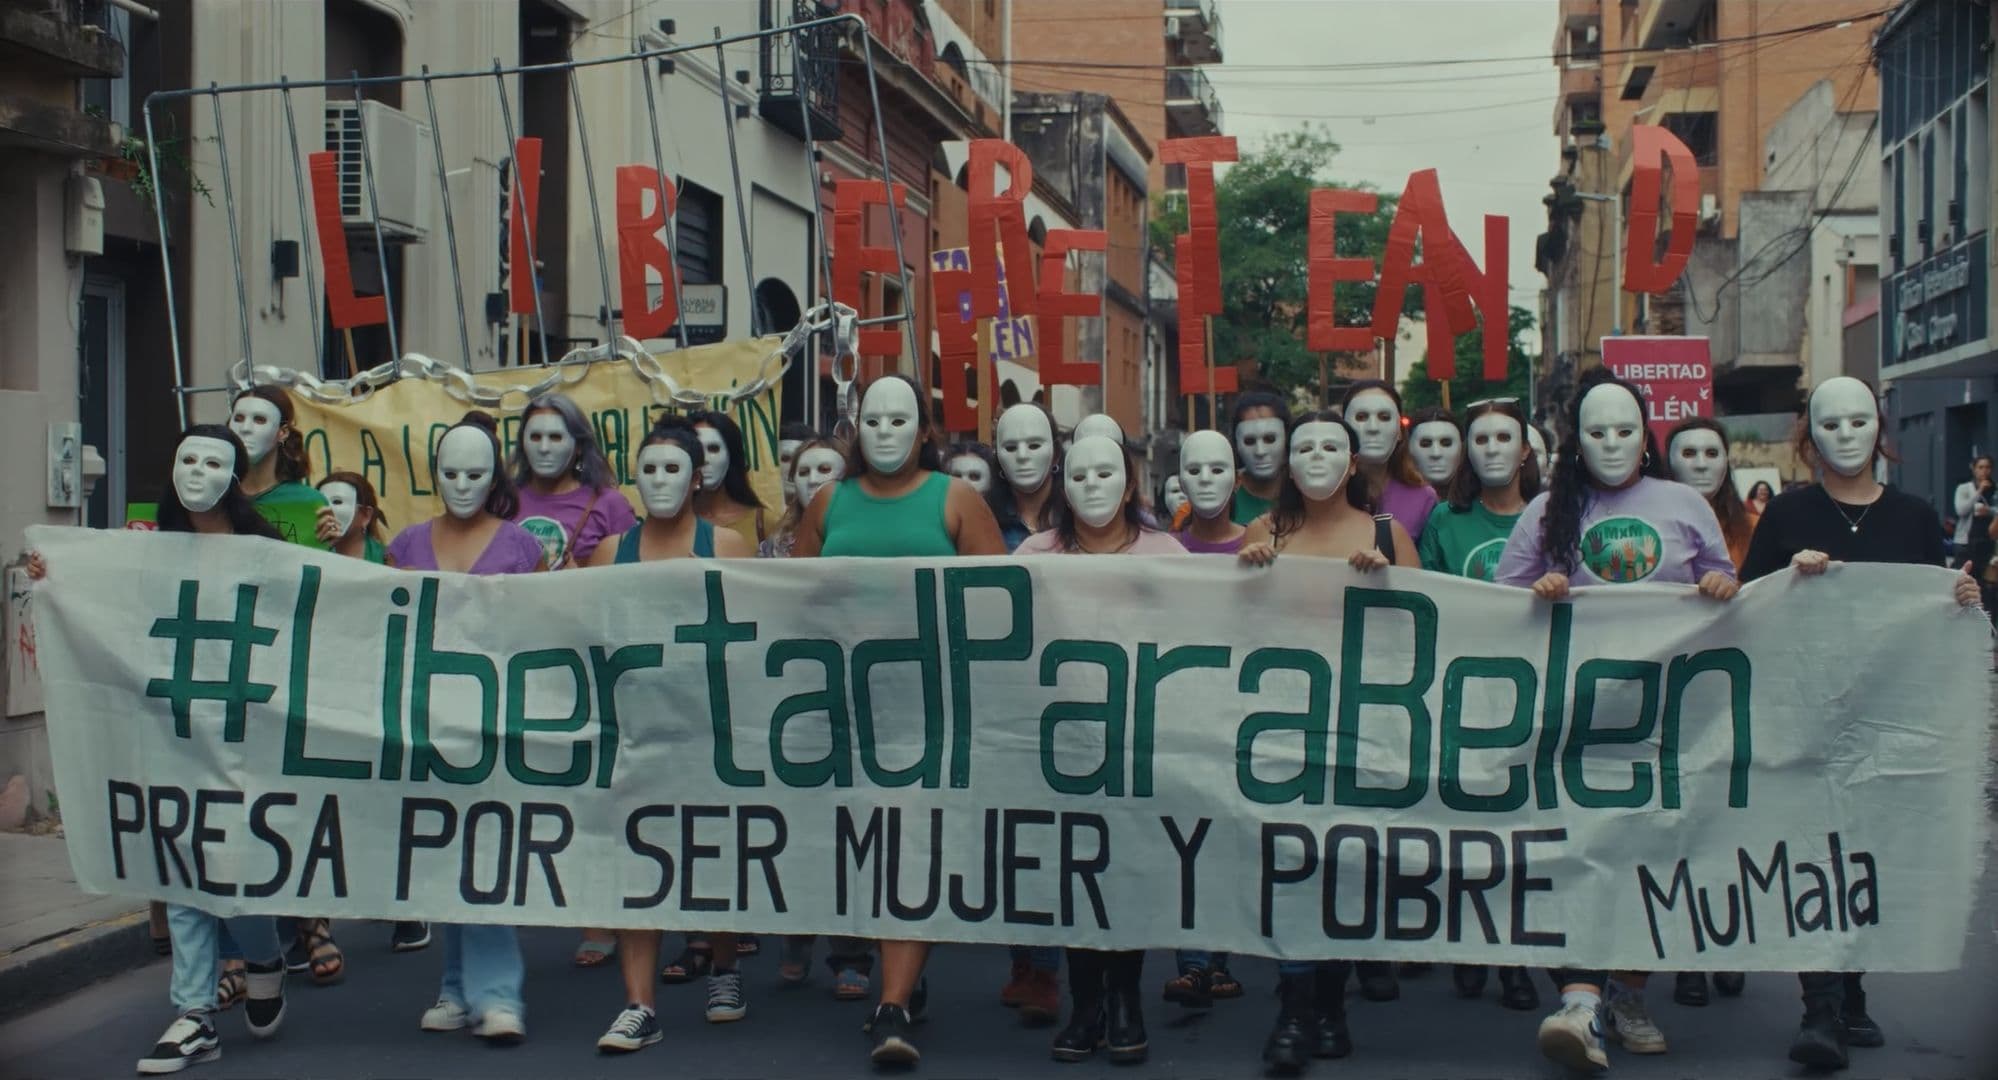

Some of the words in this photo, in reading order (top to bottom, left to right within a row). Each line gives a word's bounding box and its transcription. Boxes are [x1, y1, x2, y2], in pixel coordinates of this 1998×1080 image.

[1613, 363, 1706, 379] LIBERTAD
[1648, 395, 1699, 420] LÉN
[360, 428, 386, 497] A
[146, 564, 1752, 812] #LibertadParaBelen
[107, 779, 348, 898] PRESA
[396, 796, 575, 908] POR
[623, 804, 789, 913] SER
[835, 805, 1111, 930] MUJER
[1160, 816, 1213, 930] Y
[1260, 822, 1568, 947] POBRE
[1636, 832, 1880, 960] MuMala
